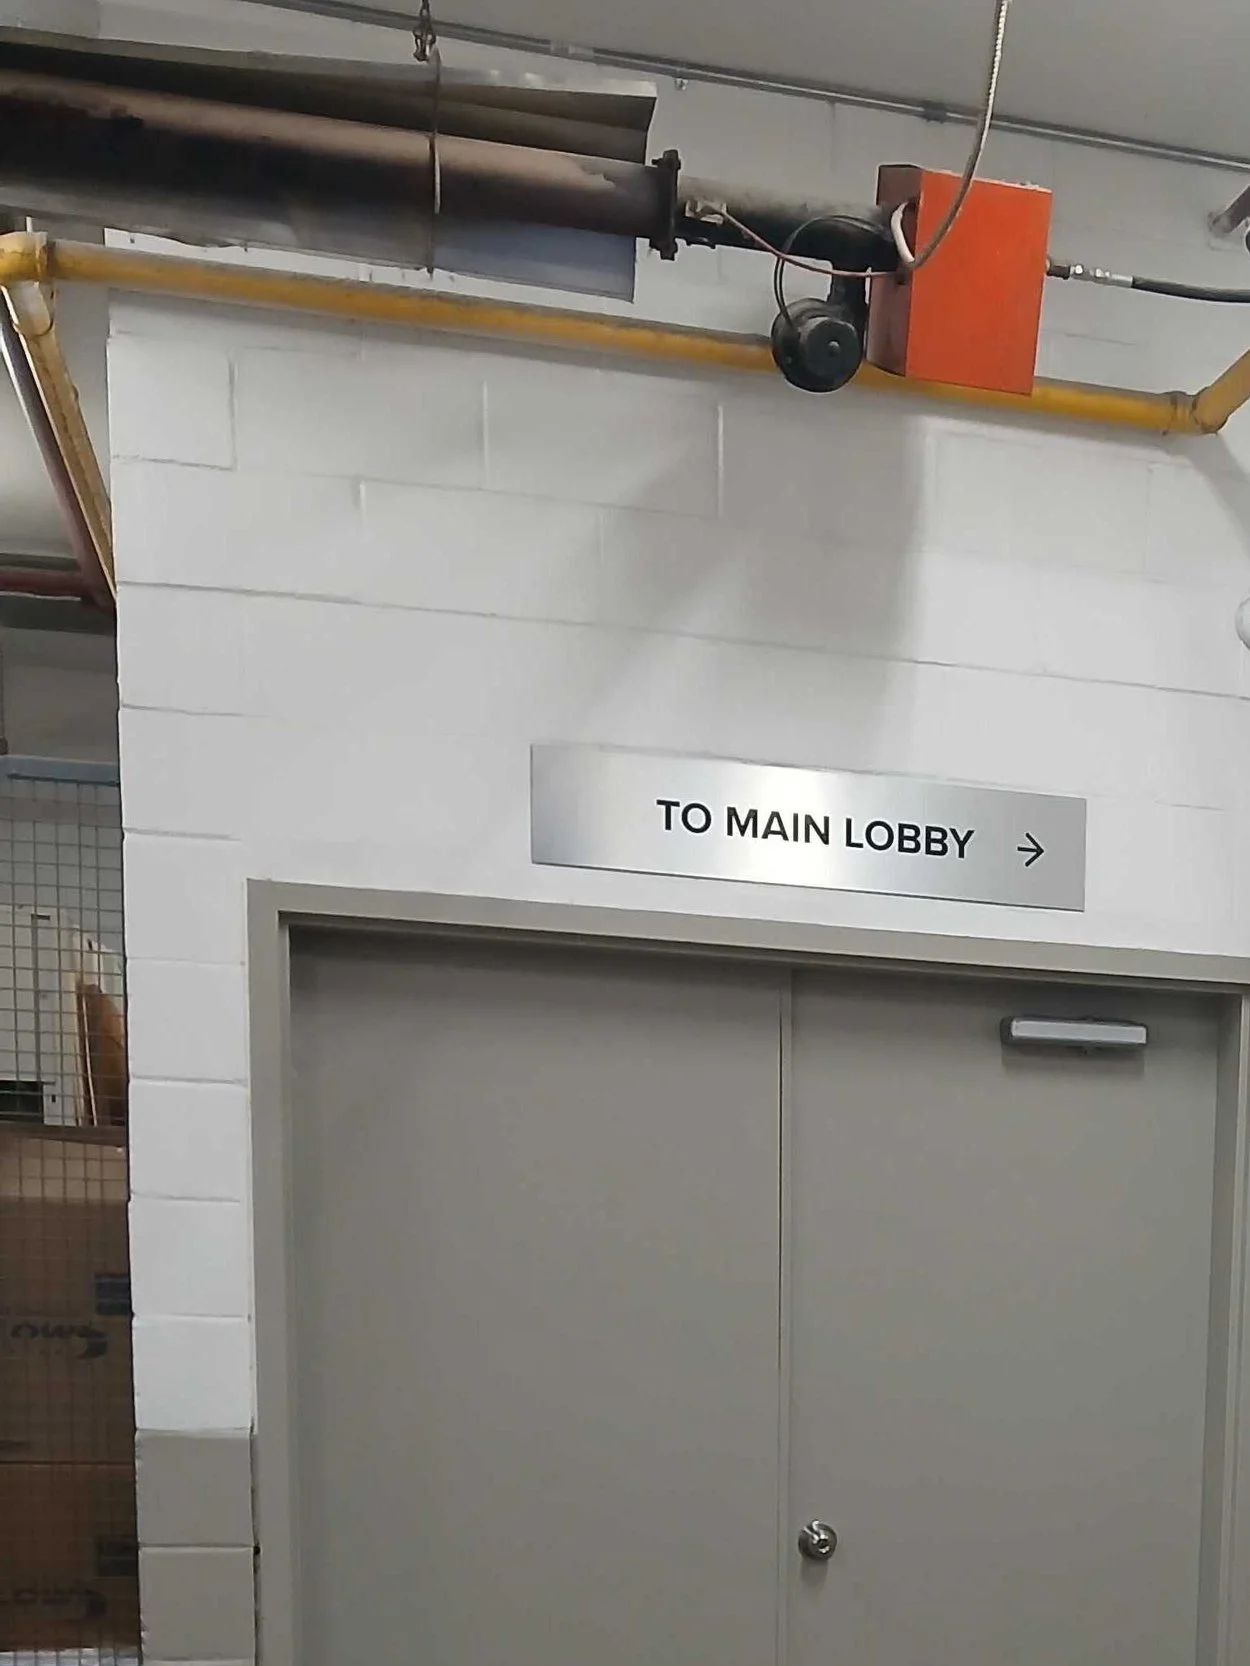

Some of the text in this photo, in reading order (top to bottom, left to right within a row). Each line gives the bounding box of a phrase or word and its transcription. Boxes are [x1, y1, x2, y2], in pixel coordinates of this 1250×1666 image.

[656, 799, 975, 859] TO MAIN LOBBY
